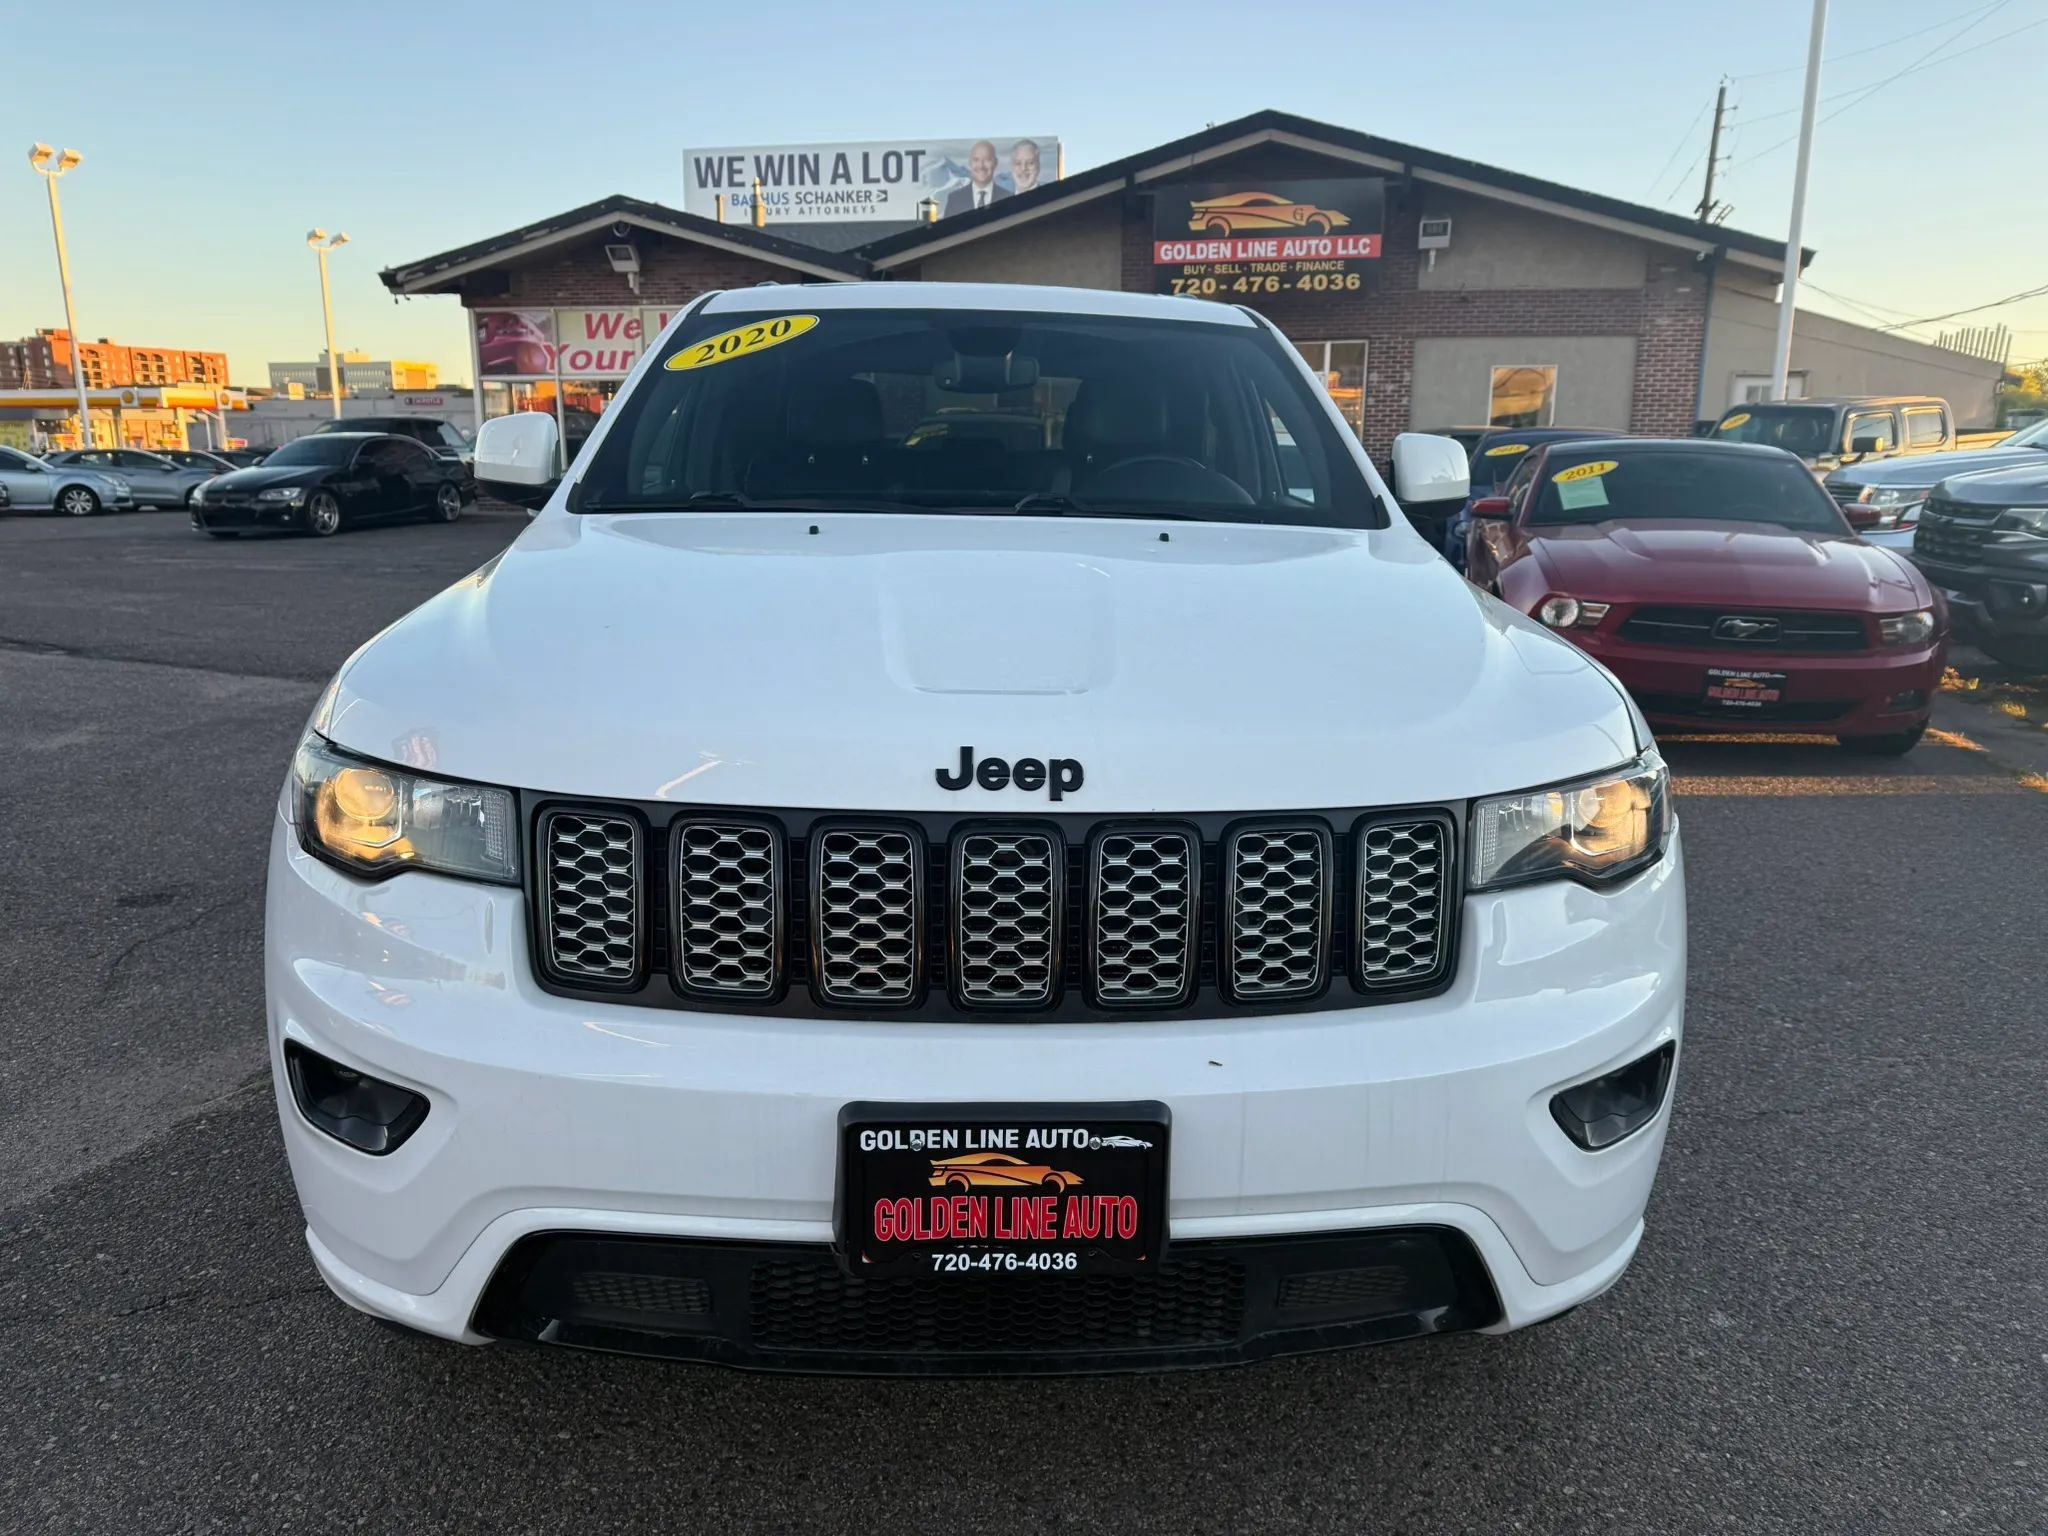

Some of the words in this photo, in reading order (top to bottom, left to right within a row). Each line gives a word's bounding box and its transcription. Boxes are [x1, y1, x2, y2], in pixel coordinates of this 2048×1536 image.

[694, 155, 746, 189] WE
[753, 152, 820, 187] WIN
[829, 152, 853, 186] A
[862, 149, 926, 184] LOT
[795, 189, 873, 205] SCHANKER
[798, 204, 876, 216] ATTORNEYS
[1160, 242, 1232, 260] GOLDEN
[1237, 240, 1278, 258] LINE
[1282, 239, 1332, 256] AUTO
[1337, 237, 1371, 255] LLC
[1183, 264, 1206, 275] BUY
[1214, 263, 1242, 274] SELL
[1250, 261, 1288, 272] TRADE
[1295, 259, 1345, 271] FINANCE
[584, 312, 642, 340] We
[694, 319, 792, 365] 2020
[542, 343, 635, 371] Your
[1564, 462, 1606, 480] 2011
[935, 746, 1084, 801] Jeep
[860, 1129, 958, 1151] GOLDEN
[965, 1129, 1019, 1148] LINE
[1025, 1128, 1089, 1149] AUTO
[874, 1196, 988, 1241] GOLDEN
[994, 1197, 1057, 1240] LINE
[1063, 1196, 1137, 1239] AUTO
[932, 1252, 1078, 1271] 720-476-4036
